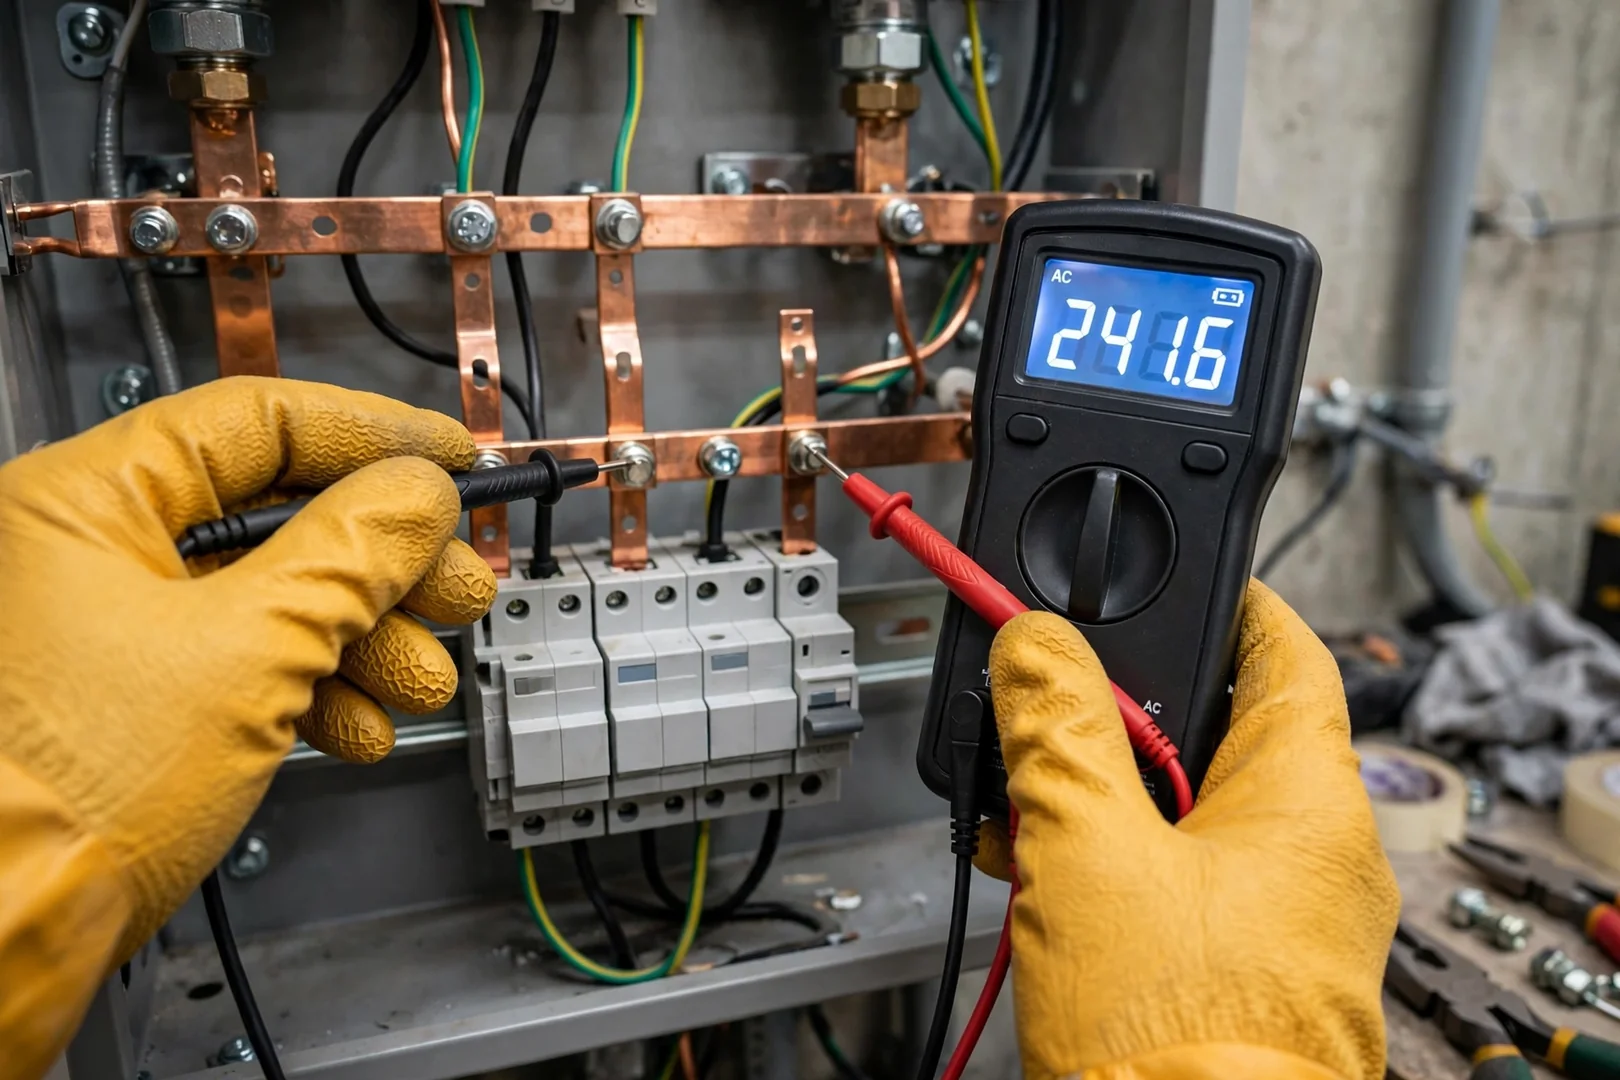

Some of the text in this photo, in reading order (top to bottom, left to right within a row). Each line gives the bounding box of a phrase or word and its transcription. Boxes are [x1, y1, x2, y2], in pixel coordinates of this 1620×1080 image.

[1051, 269, 1073, 284] AC
[1047, 298, 1234, 390] 241.6
[1143, 700, 1163, 715] AC
